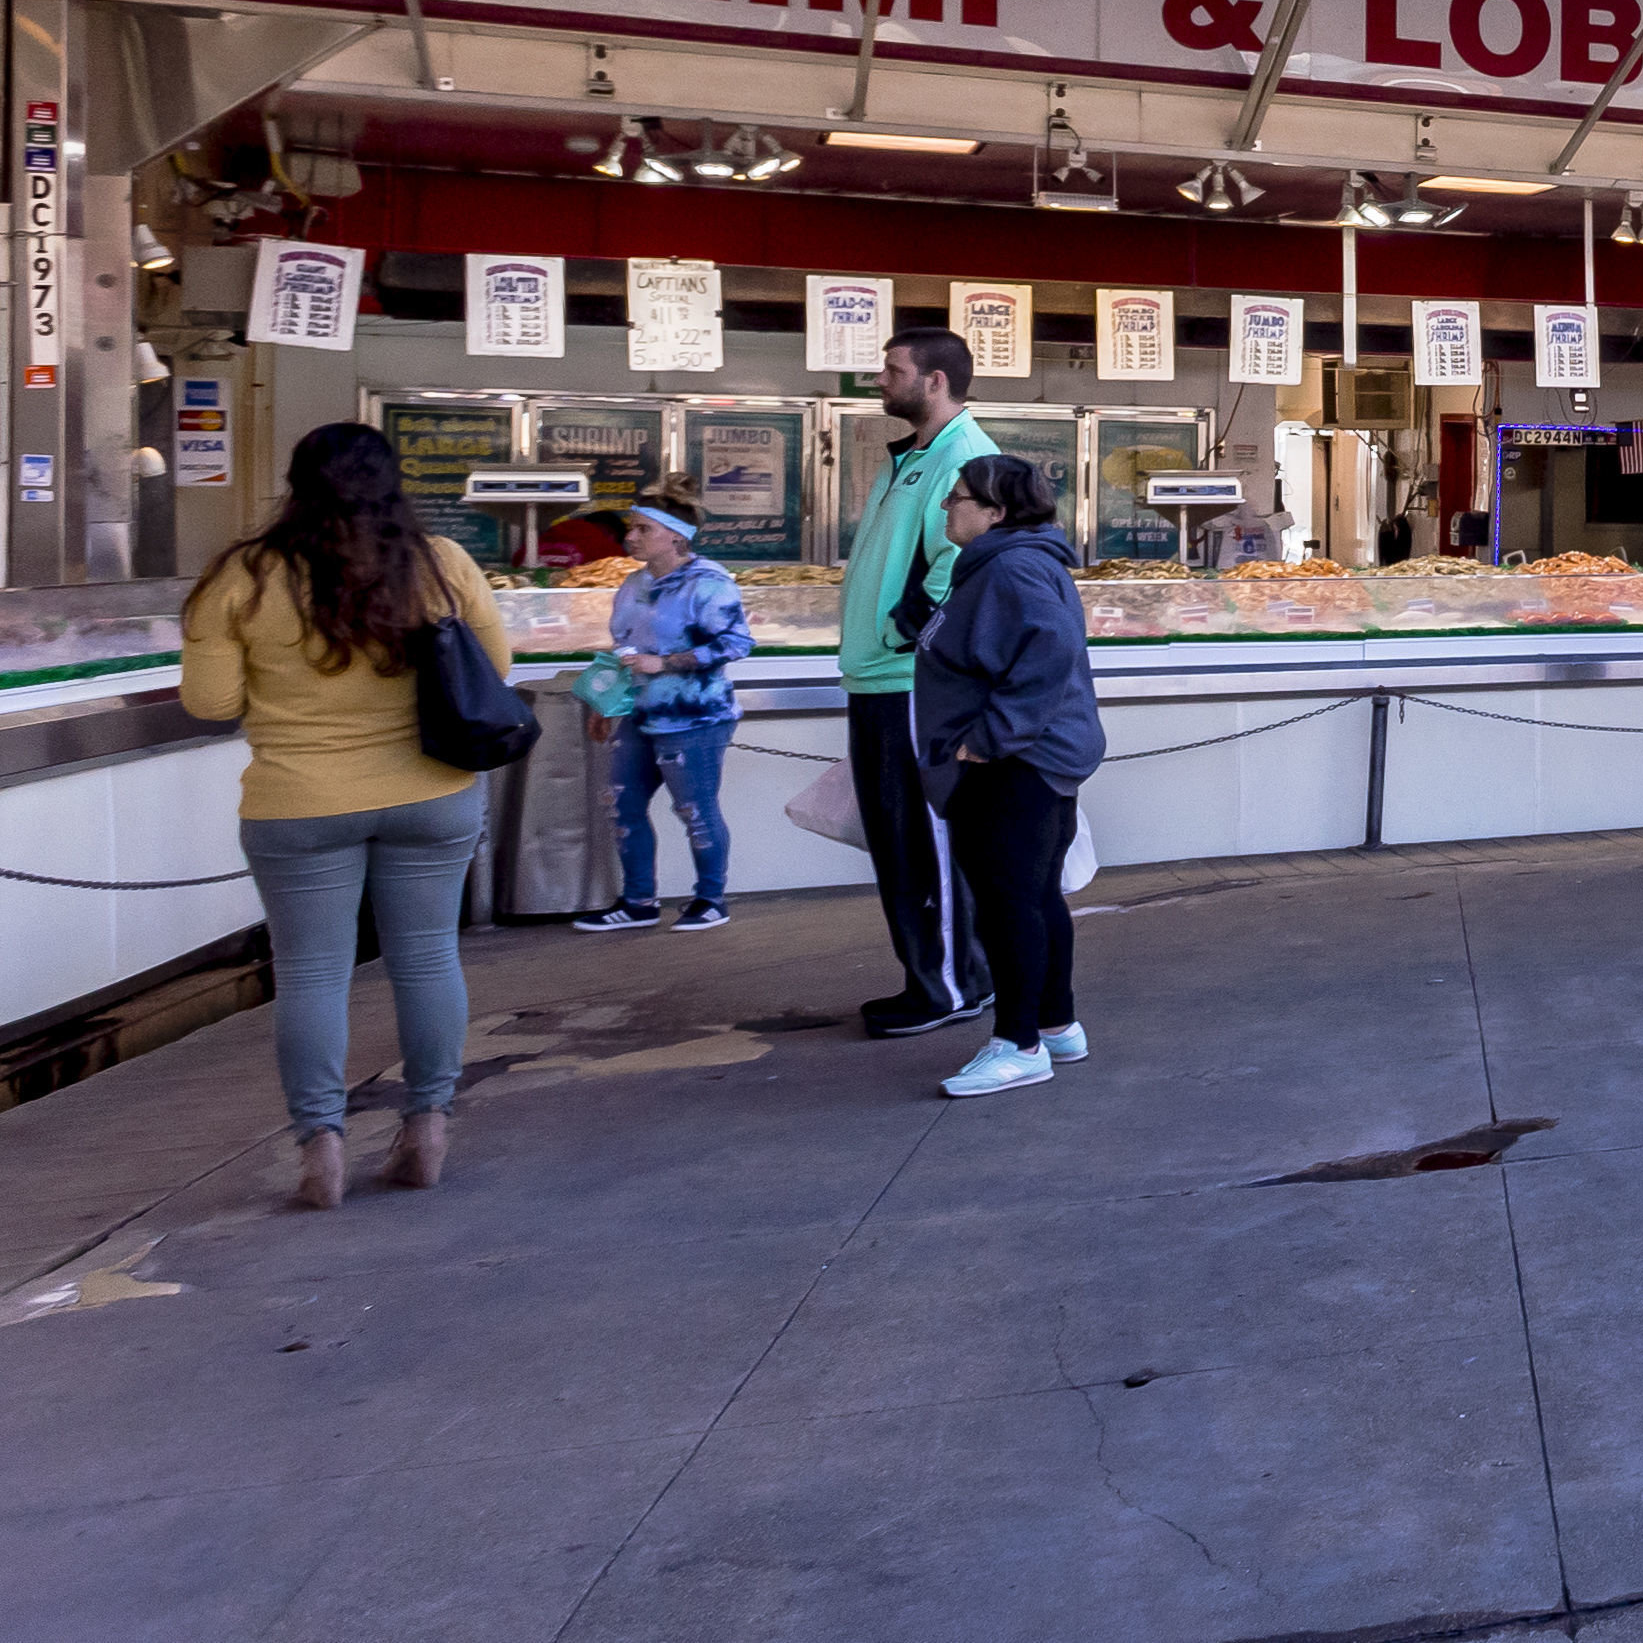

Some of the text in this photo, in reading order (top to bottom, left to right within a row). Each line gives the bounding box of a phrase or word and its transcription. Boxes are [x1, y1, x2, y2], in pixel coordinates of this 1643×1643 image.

[552, 426, 649, 456] SHRIMP
[707, 427, 772, 445] JUMBO
[1513, 430, 1581, 445] DC2944N
[182, 439, 226, 452] VISA
